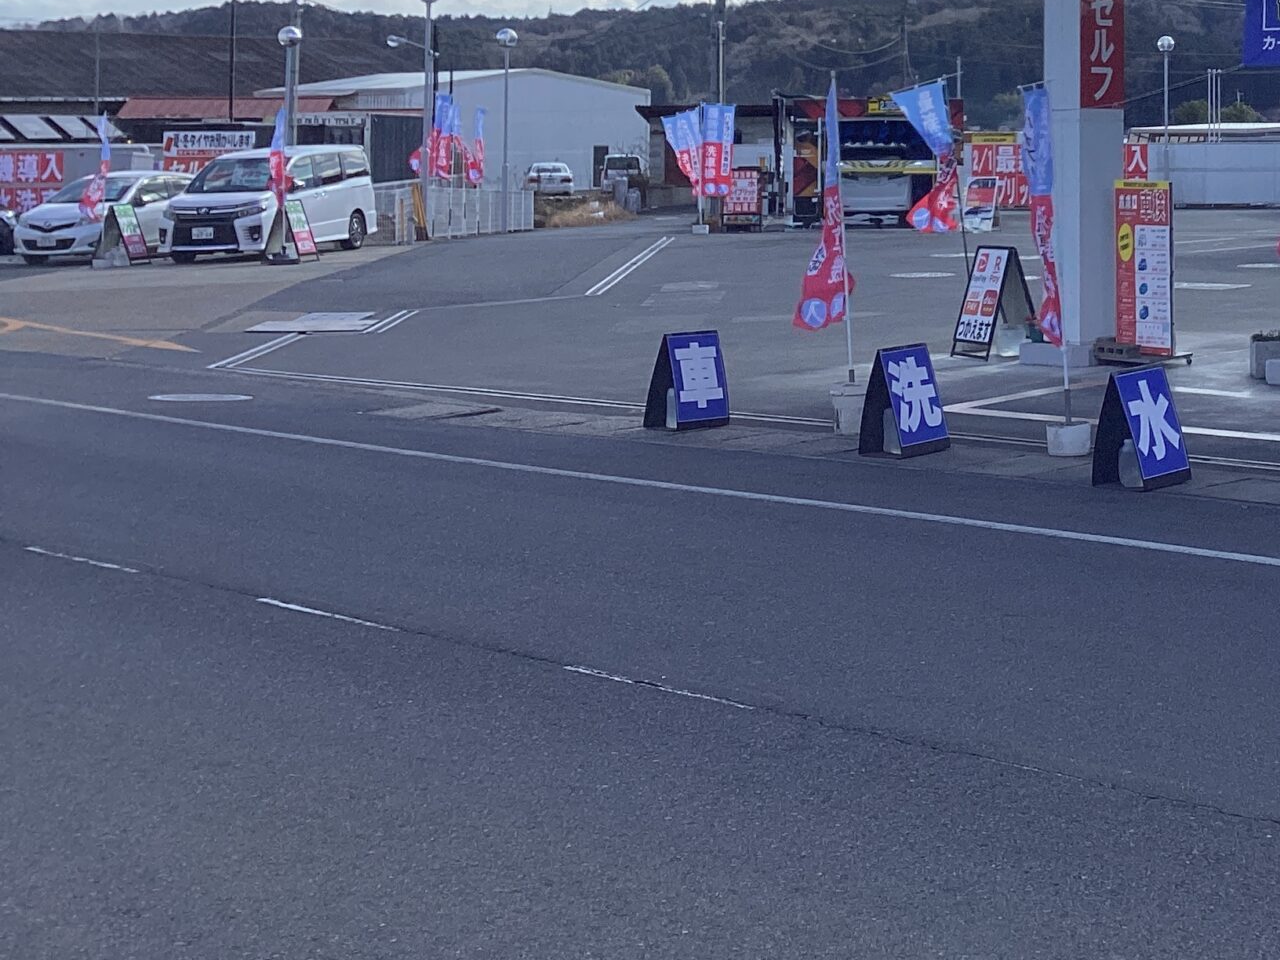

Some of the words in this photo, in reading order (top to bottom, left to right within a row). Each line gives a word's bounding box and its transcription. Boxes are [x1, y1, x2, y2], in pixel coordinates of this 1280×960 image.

[994, 256, 1001, 271] R
[959, 321, 991, 340] つかえます
[675, 343, 723, 408] 車
[888, 357, 941, 432] 洗
[1128, 380, 1179, 460] 水
